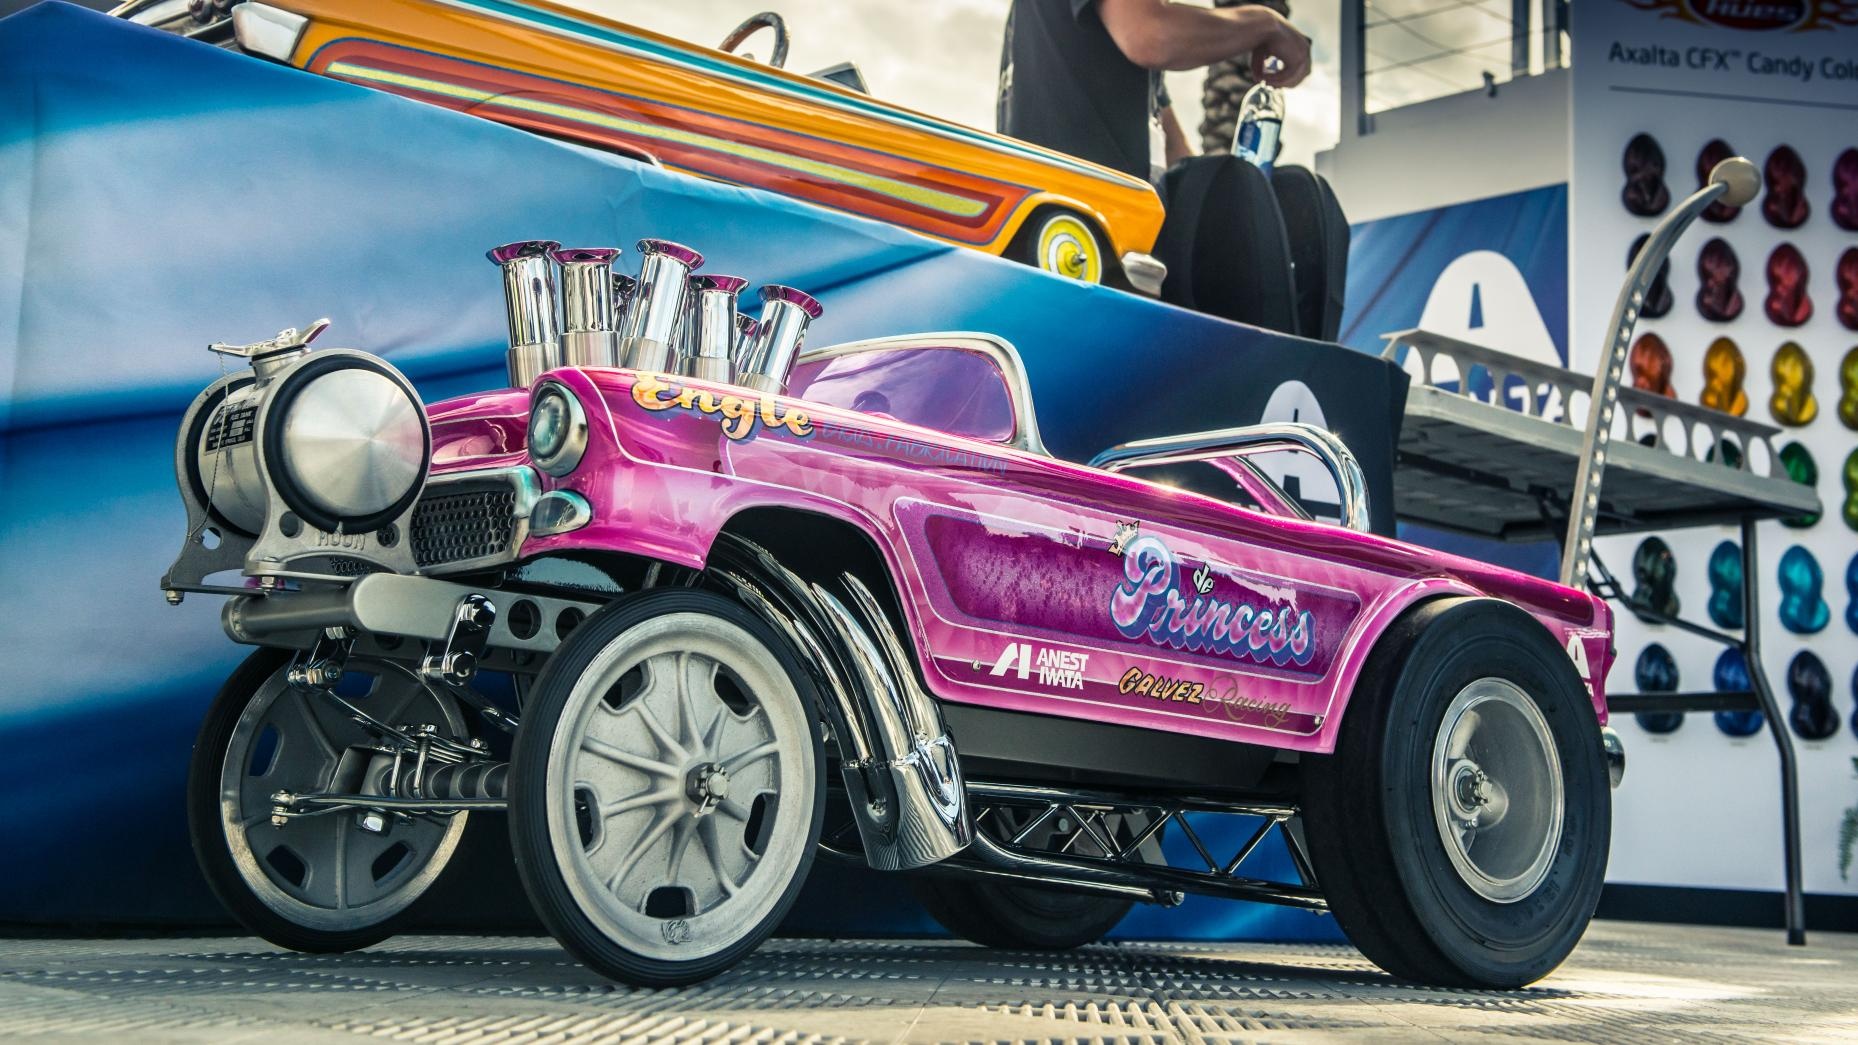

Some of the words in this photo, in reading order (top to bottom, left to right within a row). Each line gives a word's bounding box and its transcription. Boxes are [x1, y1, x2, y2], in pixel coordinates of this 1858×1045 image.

[1609, 41, 1680, 68] Axalta
[1747, 52, 1814, 82] Candy
[631, 371, 817, 443] Engle
[1110, 536, 1316, 666] Princess
[1036, 647, 1089, 672] ANEST
[1039, 666, 1084, 690] IWATA
[1202, 675, 1291, 728] Racing
